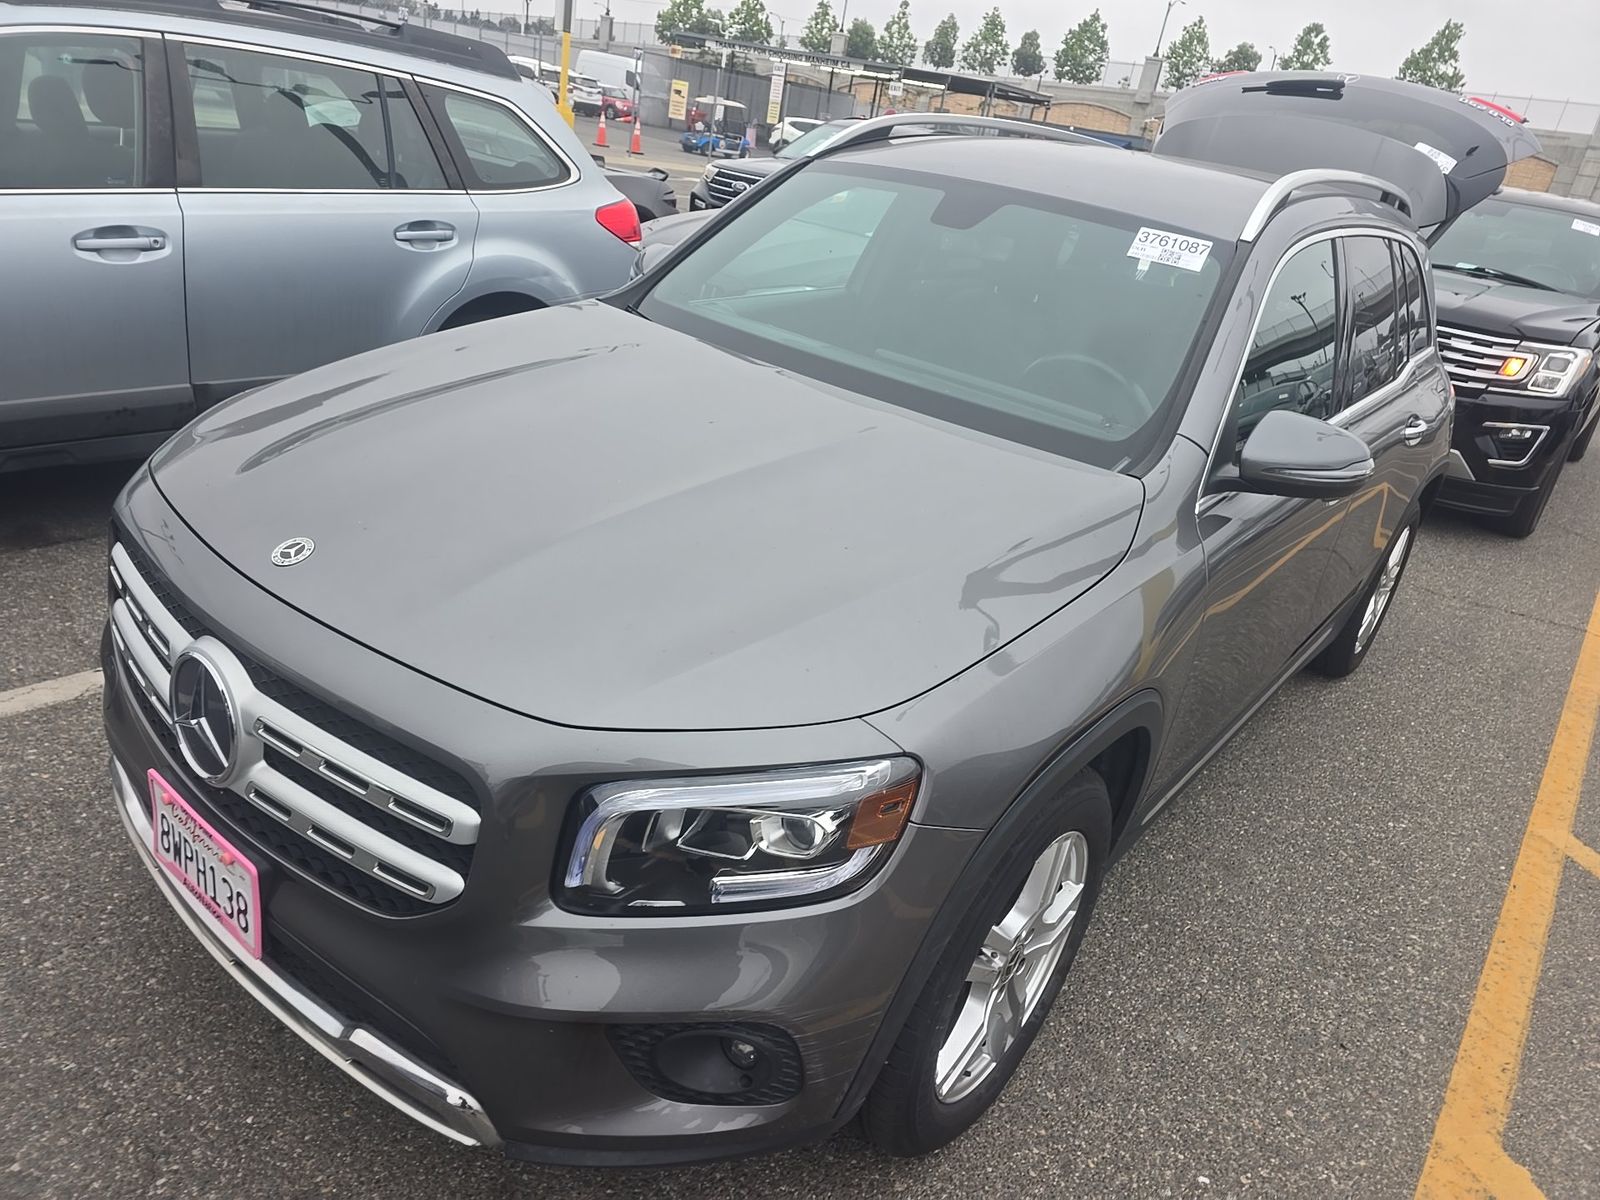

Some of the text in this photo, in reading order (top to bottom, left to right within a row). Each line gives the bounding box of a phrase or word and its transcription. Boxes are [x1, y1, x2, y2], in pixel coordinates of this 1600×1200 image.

[715, 40, 736, 49] THANK
[753, 46, 767, 55] FOR
[768, 49, 803, 61] CHOOSING
[804, 54, 840, 67] MANHEIM
[1139, 231, 1210, 256] 3761087
[171, 803, 222, 862] Californi
[160, 813, 249, 934] 8WPH138
